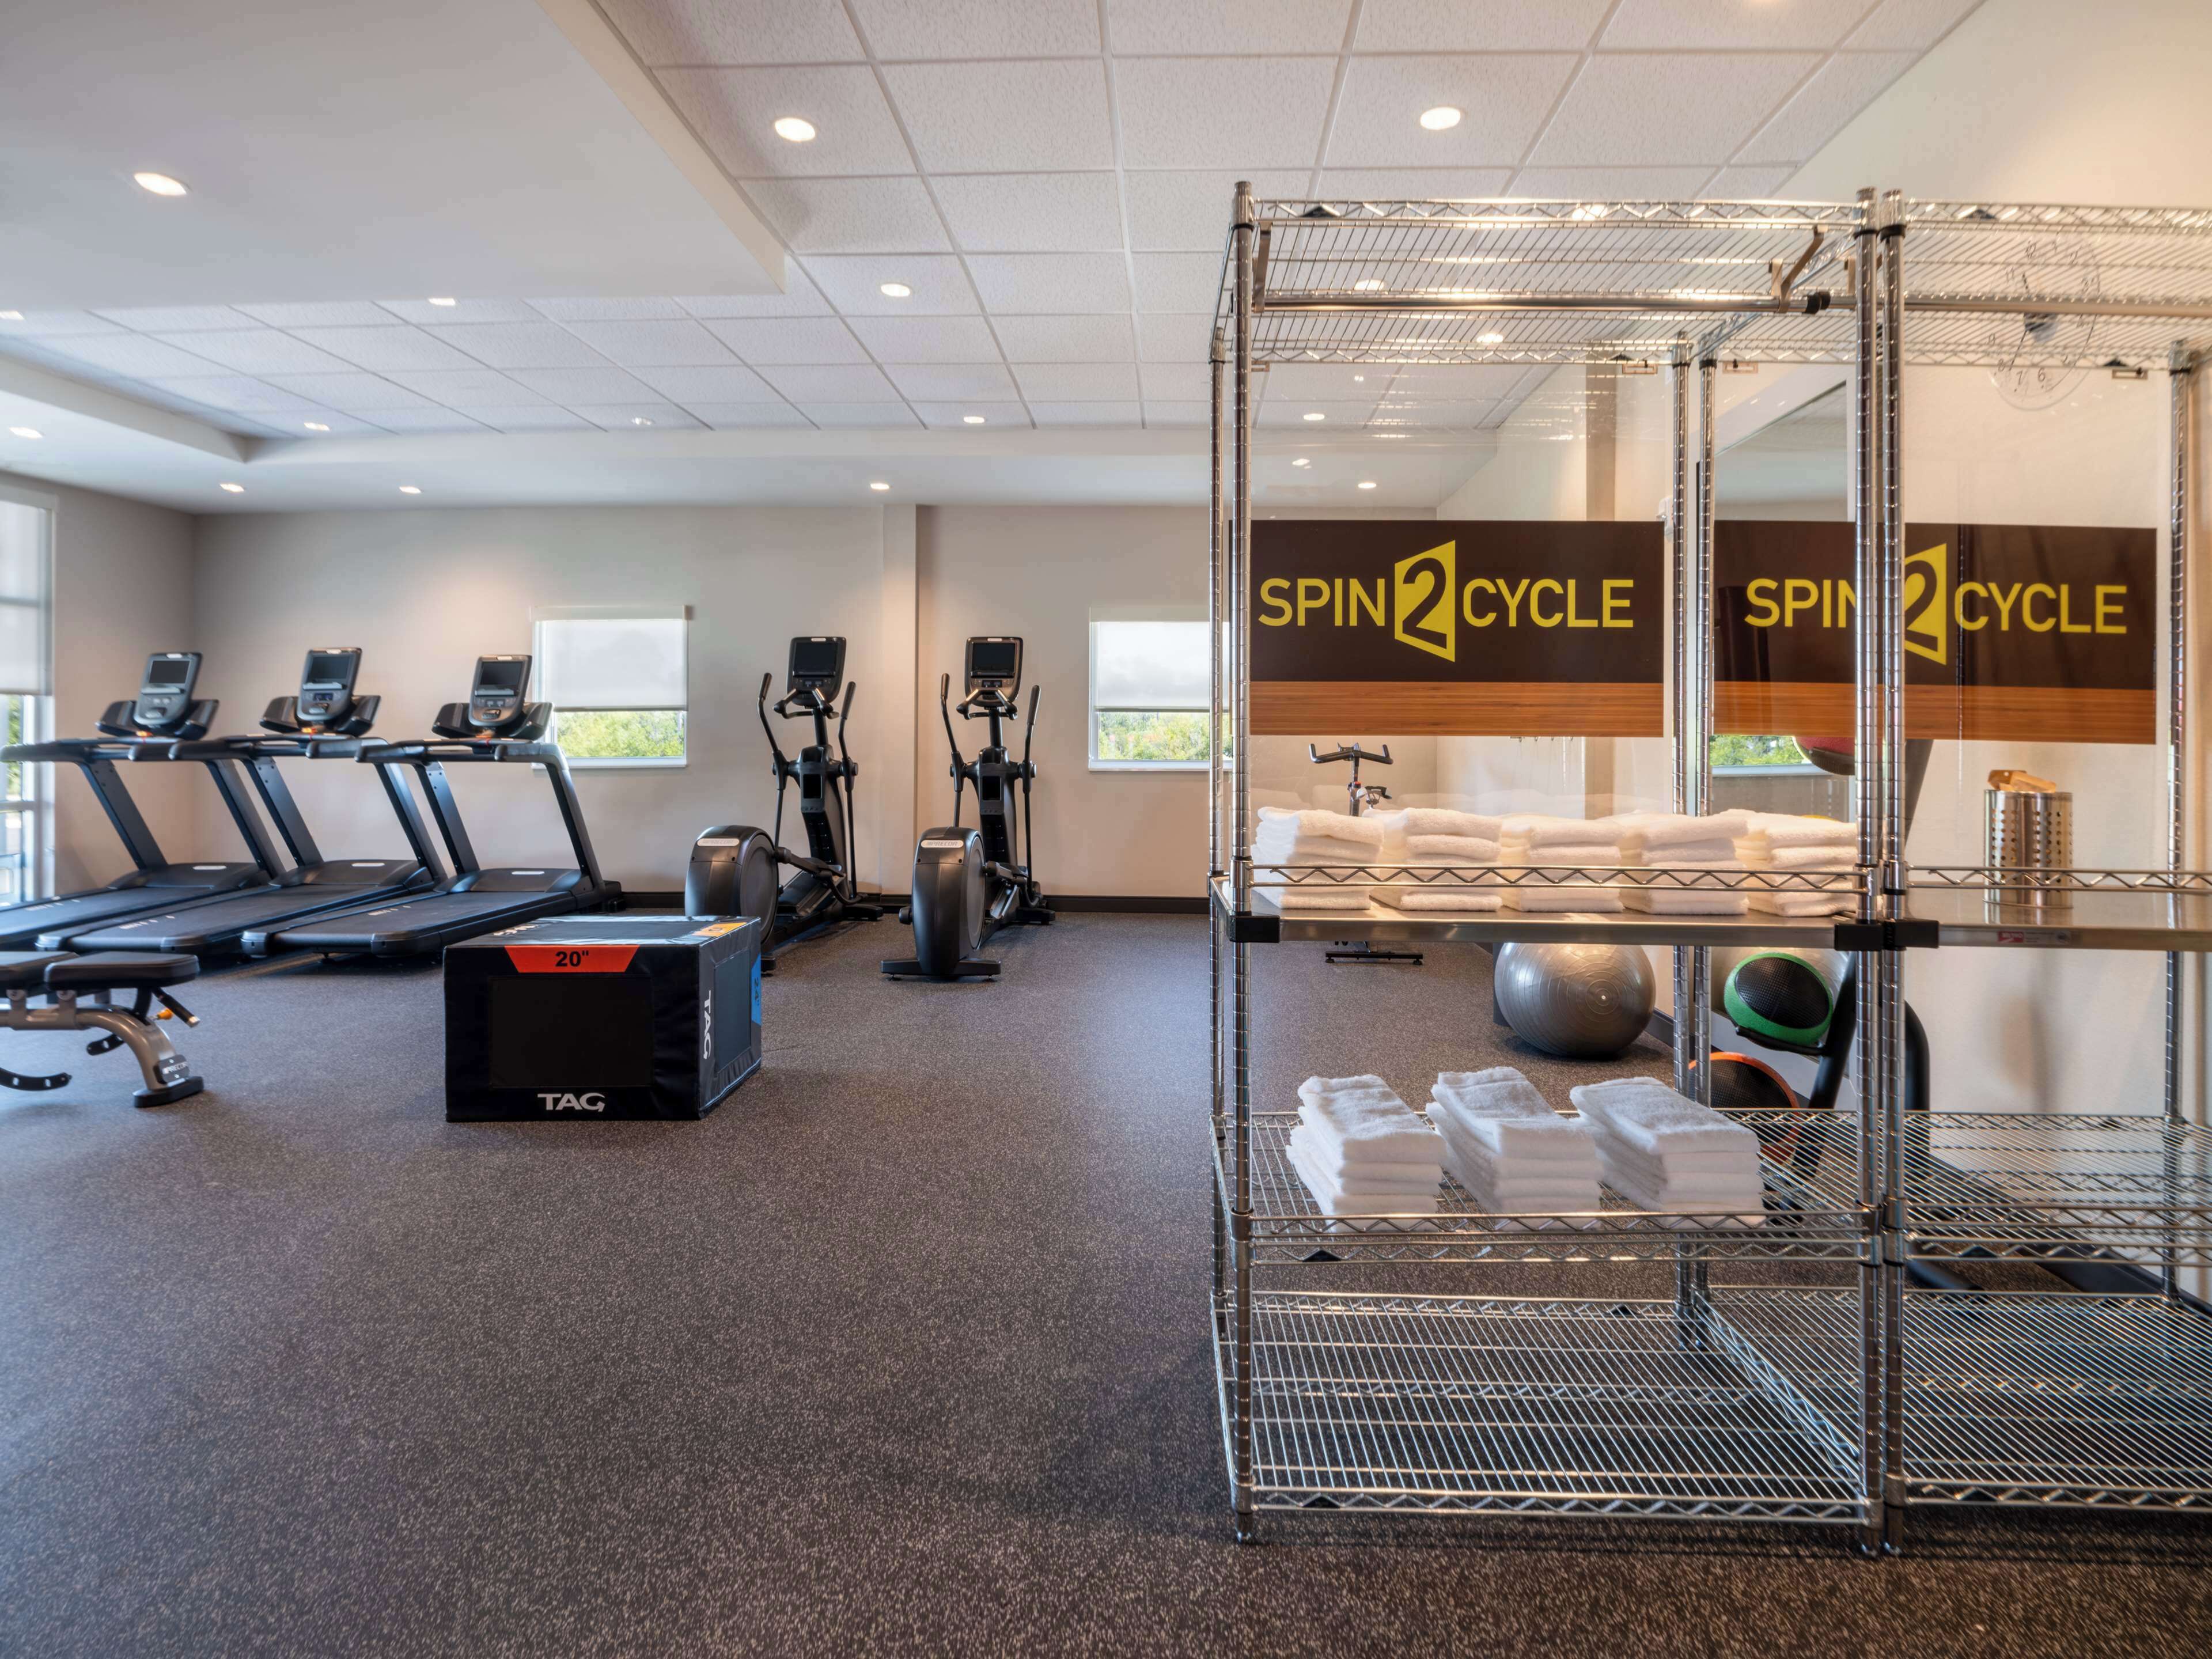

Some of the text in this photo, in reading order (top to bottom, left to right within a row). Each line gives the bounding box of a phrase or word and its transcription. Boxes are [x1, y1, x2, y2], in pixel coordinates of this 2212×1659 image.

[2016, 370, 2024, 385] 7
[2037, 367, 2046, 382] 6
[1259, 556, 1634, 650] SPIN 2 CYCLE
[1953, 581, 2127, 634] CYCLE
[555, 950, 589, 967] 20"
[703, 990, 712, 1060] TAG
[537, 1092, 605, 1112] TAG
